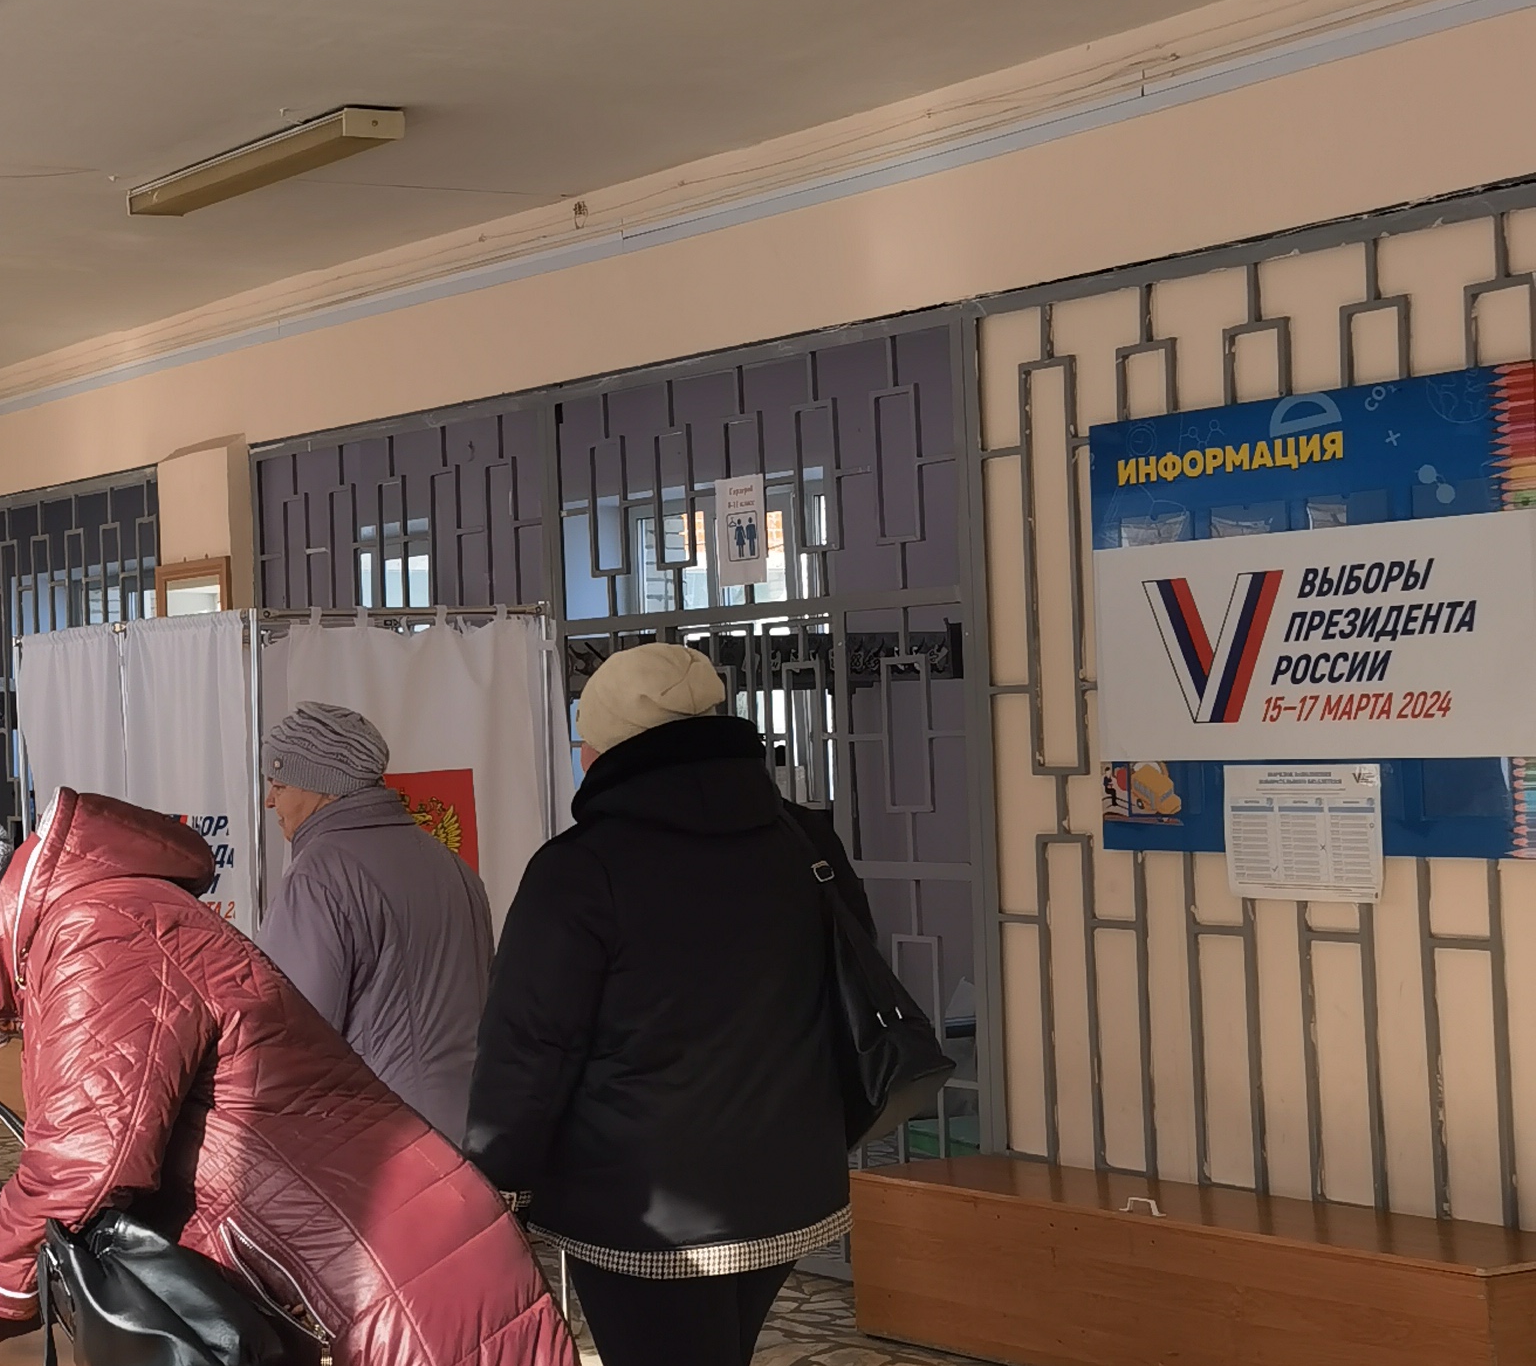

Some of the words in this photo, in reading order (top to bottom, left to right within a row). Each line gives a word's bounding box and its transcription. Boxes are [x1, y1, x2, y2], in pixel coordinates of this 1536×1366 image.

[1117, 431, 1344, 486] ИНФОРМАЦИЯ
[1297, 558, 1435, 599] ВЫБОРЫ
[1283, 600, 1477, 643] ПРЕЗИДЕНТА
[1270, 650, 1393, 686] РОССИИ
[1319, 692, 1394, 722] МАРТА
[1395, 690, 1453, 719] 2024
